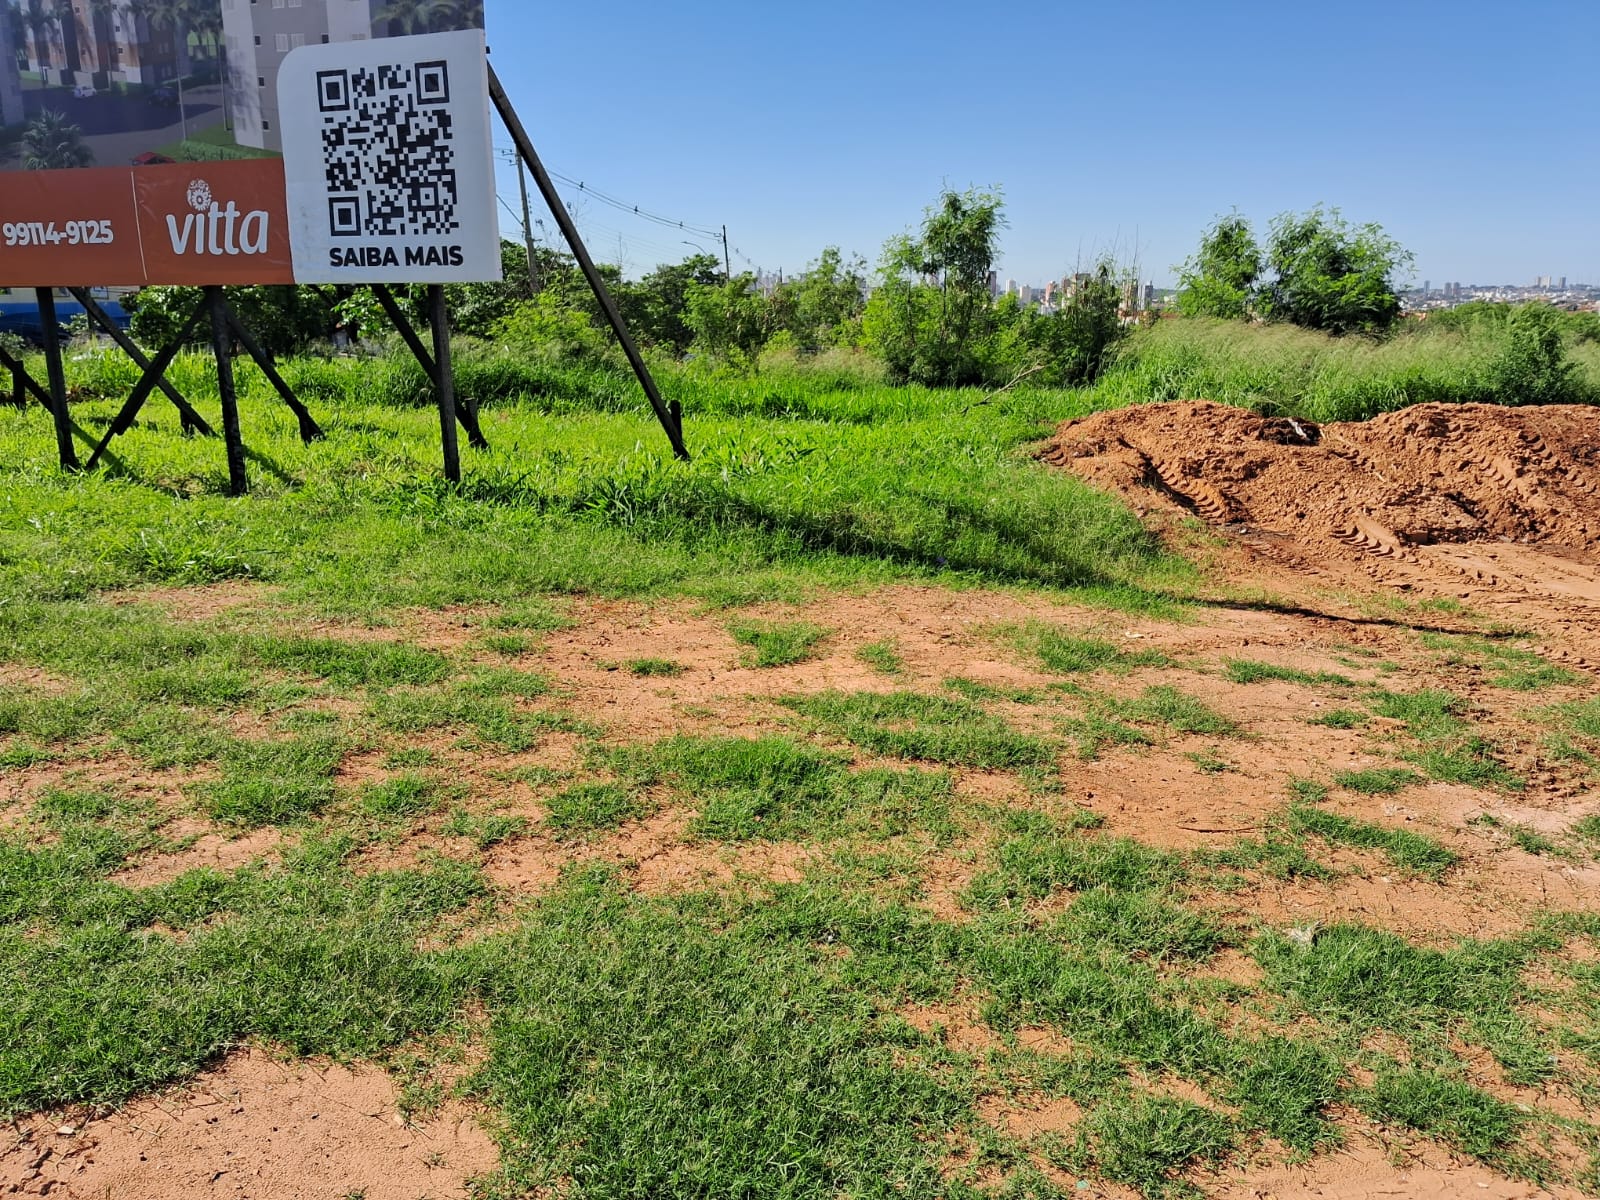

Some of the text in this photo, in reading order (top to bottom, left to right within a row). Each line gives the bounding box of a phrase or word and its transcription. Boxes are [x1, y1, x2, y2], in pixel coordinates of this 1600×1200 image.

[2, 220, 114, 246] 99114-9125
[165, 200, 269, 255] vitta
[329, 245, 464, 267] SAIBA MAIS
